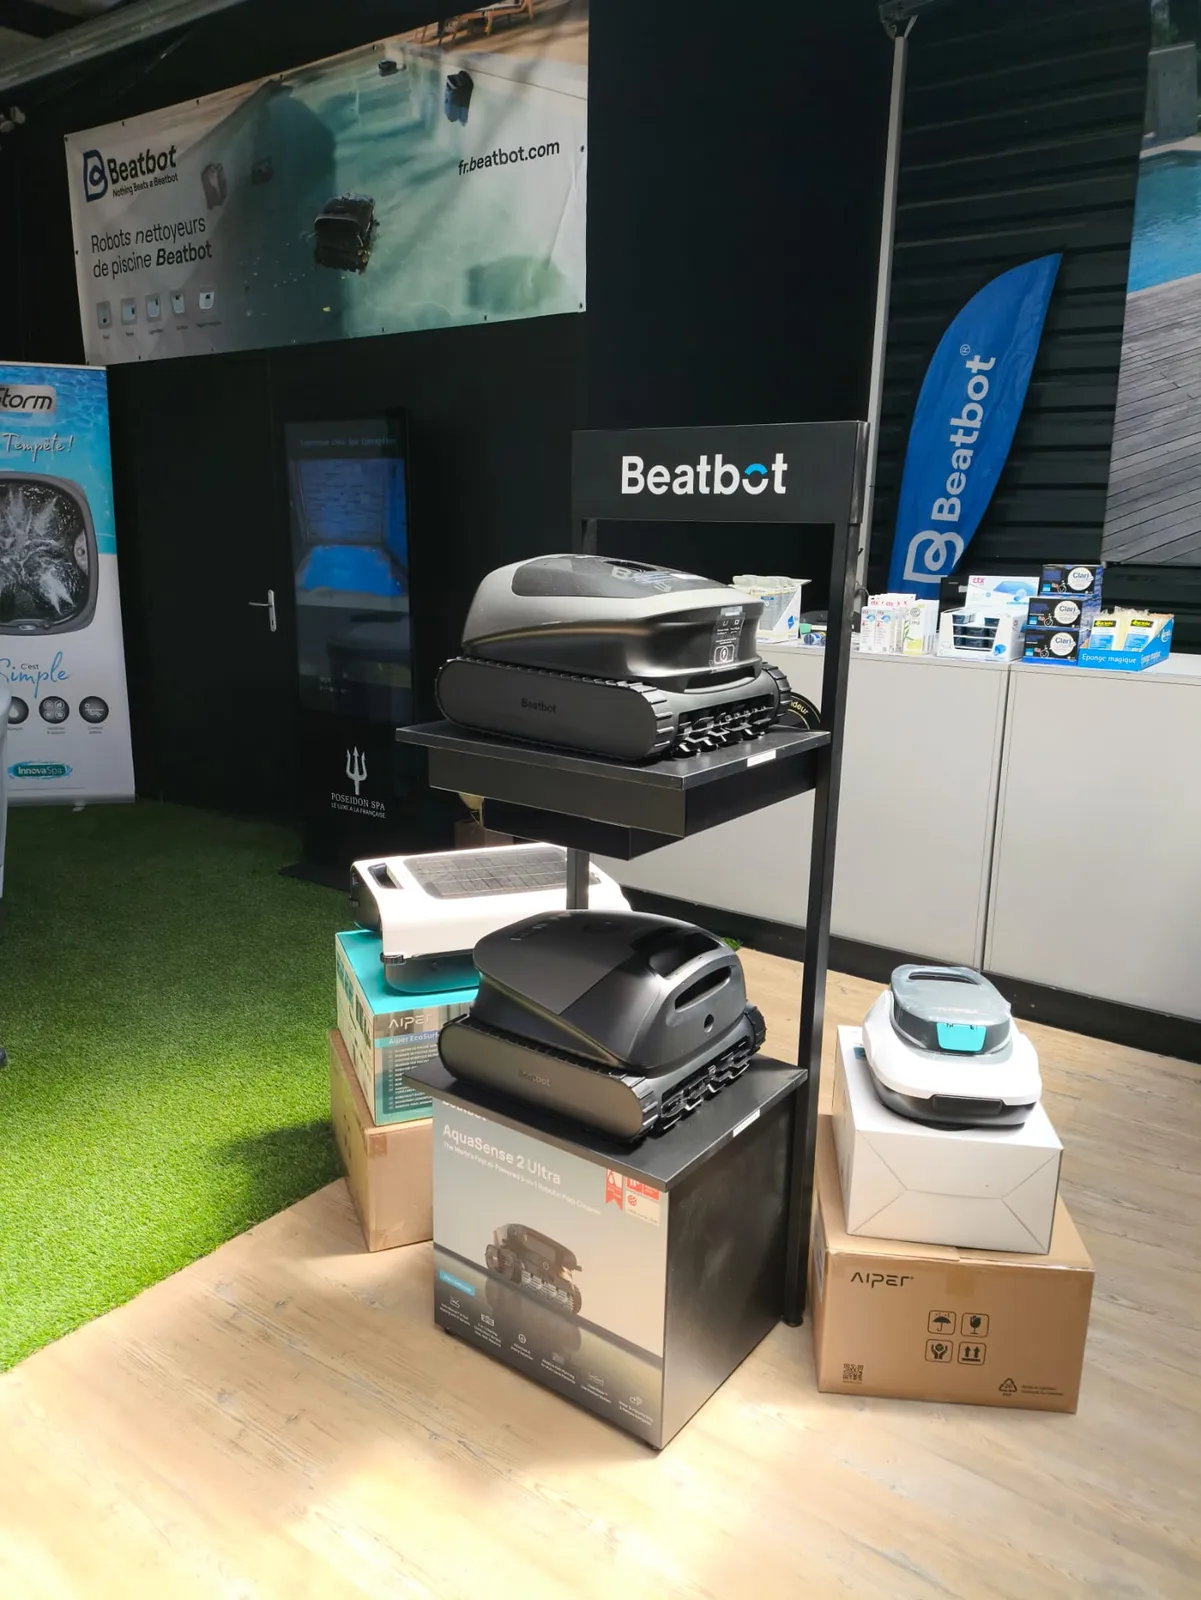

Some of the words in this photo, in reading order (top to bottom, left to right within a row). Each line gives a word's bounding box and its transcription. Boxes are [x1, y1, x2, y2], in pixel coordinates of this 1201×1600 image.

[107, 145, 176, 185] Beatbot
[458, 141, 560, 175] fr.beatbot.com
[113, 185, 133, 198] Nothing
[133, 181, 149, 192] Beats
[149, 180, 154, 188] a
[154, 173, 178, 187] Beatbot
[91, 219, 131, 254] Robots
[136, 217, 206, 244] nettoyeurs
[93, 260, 109, 278] de
[112, 251, 152, 280] piscine
[156, 240, 212, 267] Beatbot
[0, 387, 53, 410] torm
[621, 453, 788, 495] Beatbot
[1107, 656, 1137, 664] magique
[331, 792, 369, 807] POSEIDON
[371, 800, 385, 811] SPA
[388, 1013, 432, 1030] AIPER
[410, 1031, 440, 1042] EcoSurf
[443, 1124, 514, 1164] AquaSense
[516, 1155, 525, 1169] 2
[527, 1159, 560, 1185] Ultra
